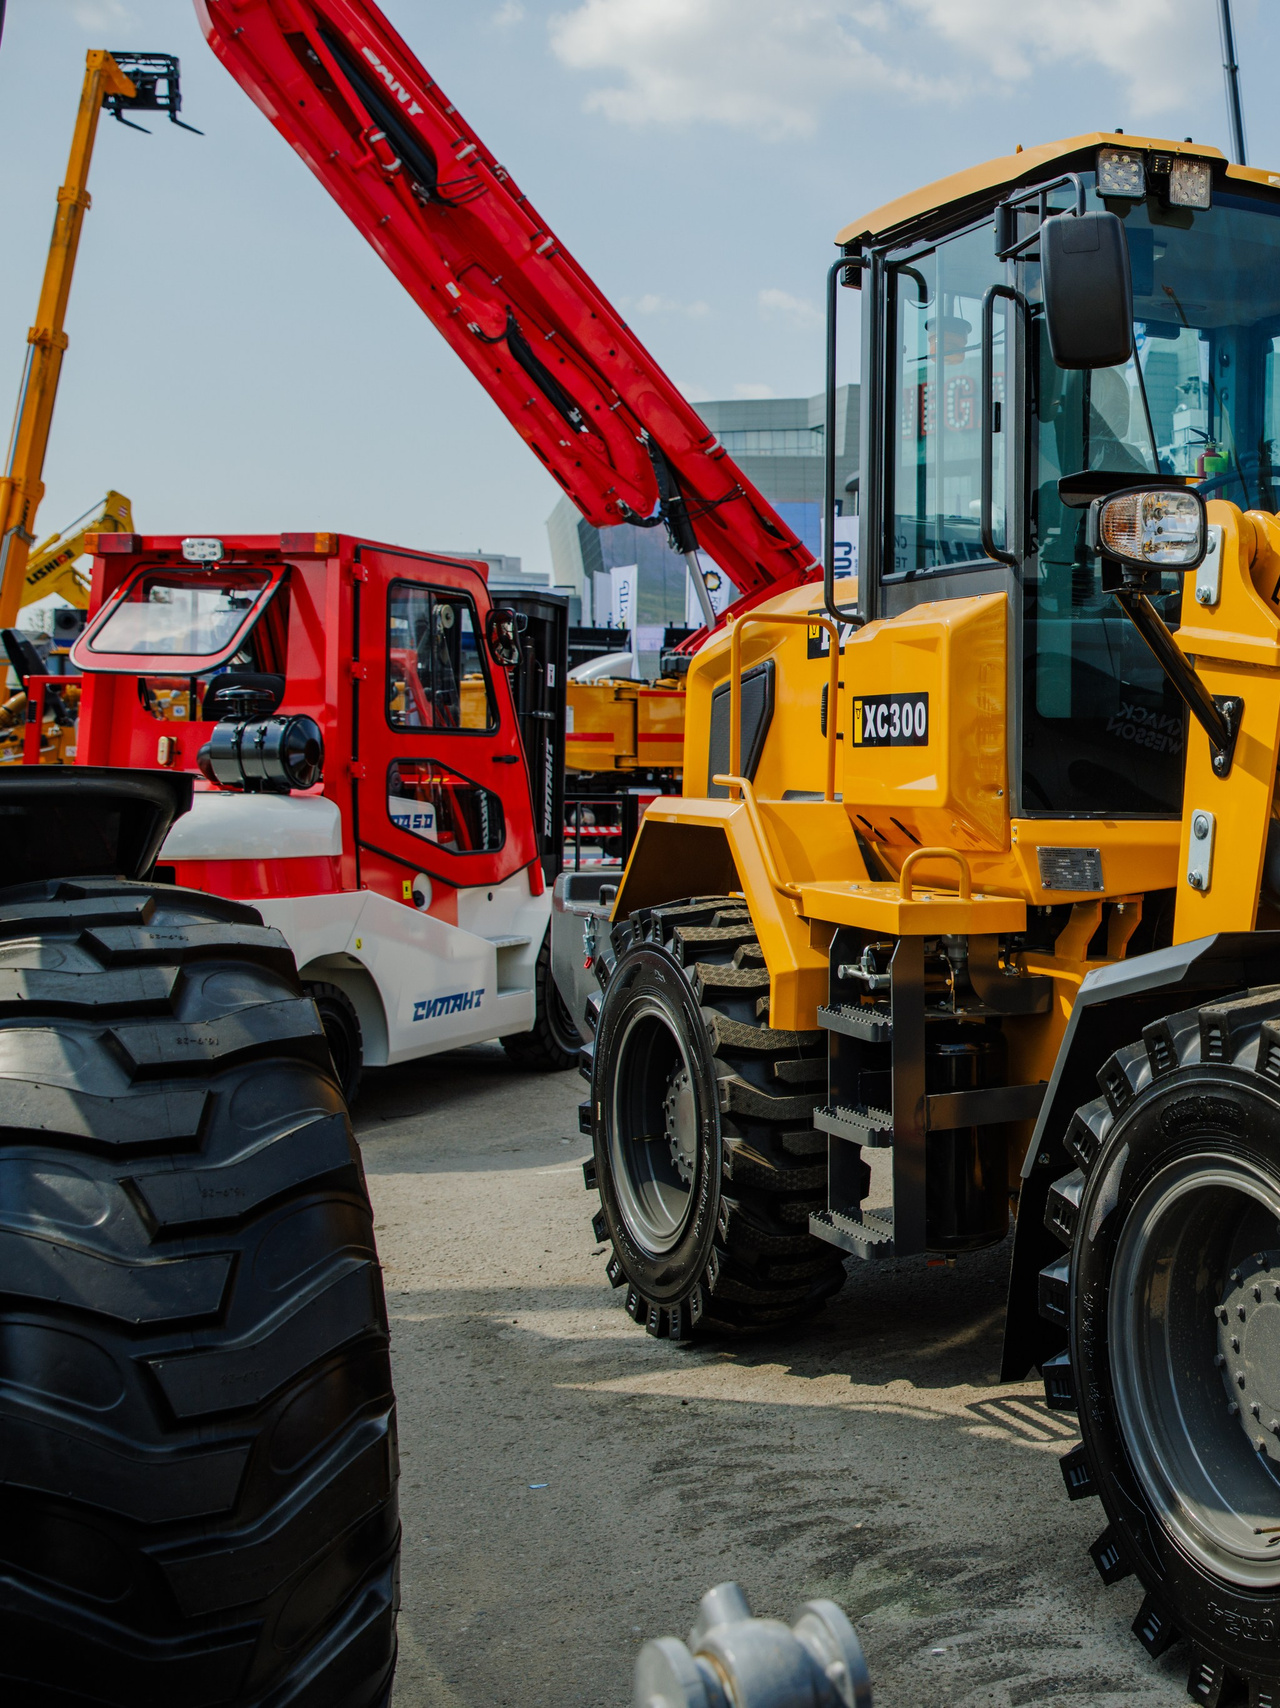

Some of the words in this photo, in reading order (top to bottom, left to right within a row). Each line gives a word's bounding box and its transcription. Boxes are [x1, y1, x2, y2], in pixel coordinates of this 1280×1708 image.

[361, 46, 424, 116] SANY
[864, 701, 927, 738] XC300
[412, 988, 485, 1022] СИЛАНТ
